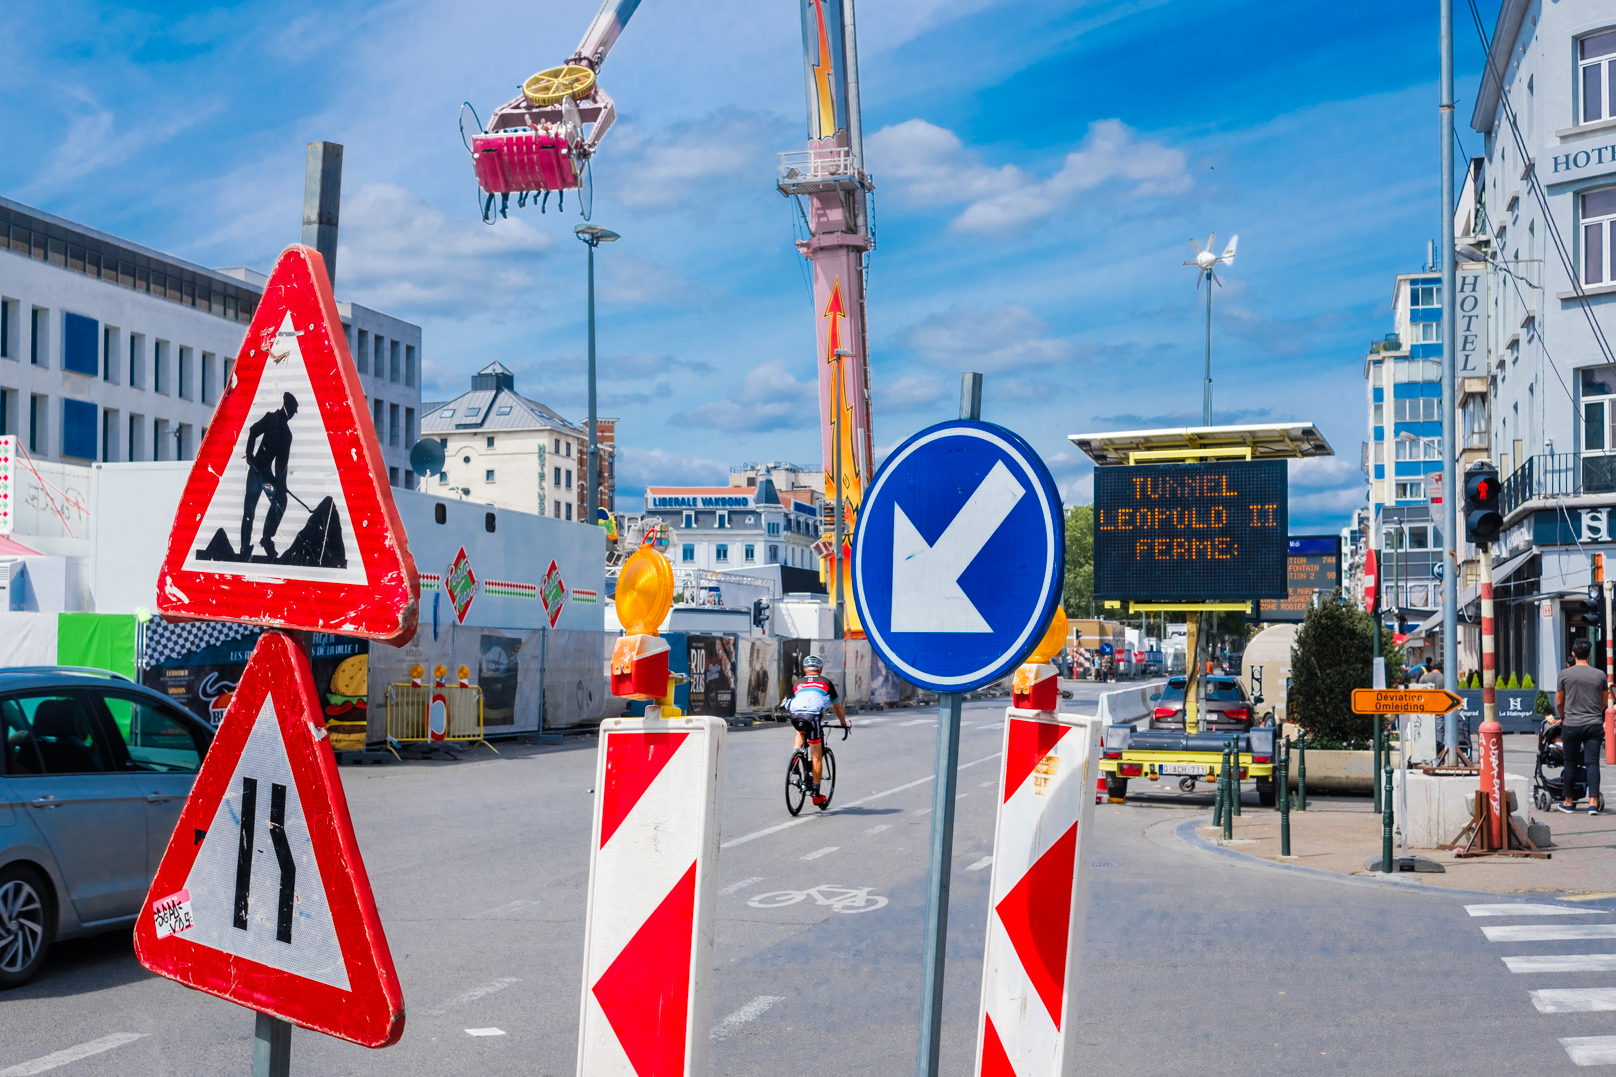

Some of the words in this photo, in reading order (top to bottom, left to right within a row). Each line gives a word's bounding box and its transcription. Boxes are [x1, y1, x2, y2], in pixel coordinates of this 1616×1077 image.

[1457, 274, 1480, 372] HOTEL
[1132, 475, 1238, 499] TUNNEL
[652, 496, 698, 507] LIBERALE
[700, 496, 749, 507] VAKBOND
[1099, 504, 1228, 531] LEOPOLD
[1249, 503, 1278, 528] II
[1322, 556, 1336, 564] 744
[1260, 603, 1277, 611] ZONE
[1280, 603, 1307, 611] ROGIER
[230, 650, 243, 662] LES
[316, 645, 325, 656] DE
[690, 648, 706, 673] RIO
[1376, 692, 1424, 702] Déviation
[1375, 702, 1426, 713] Omleiding
